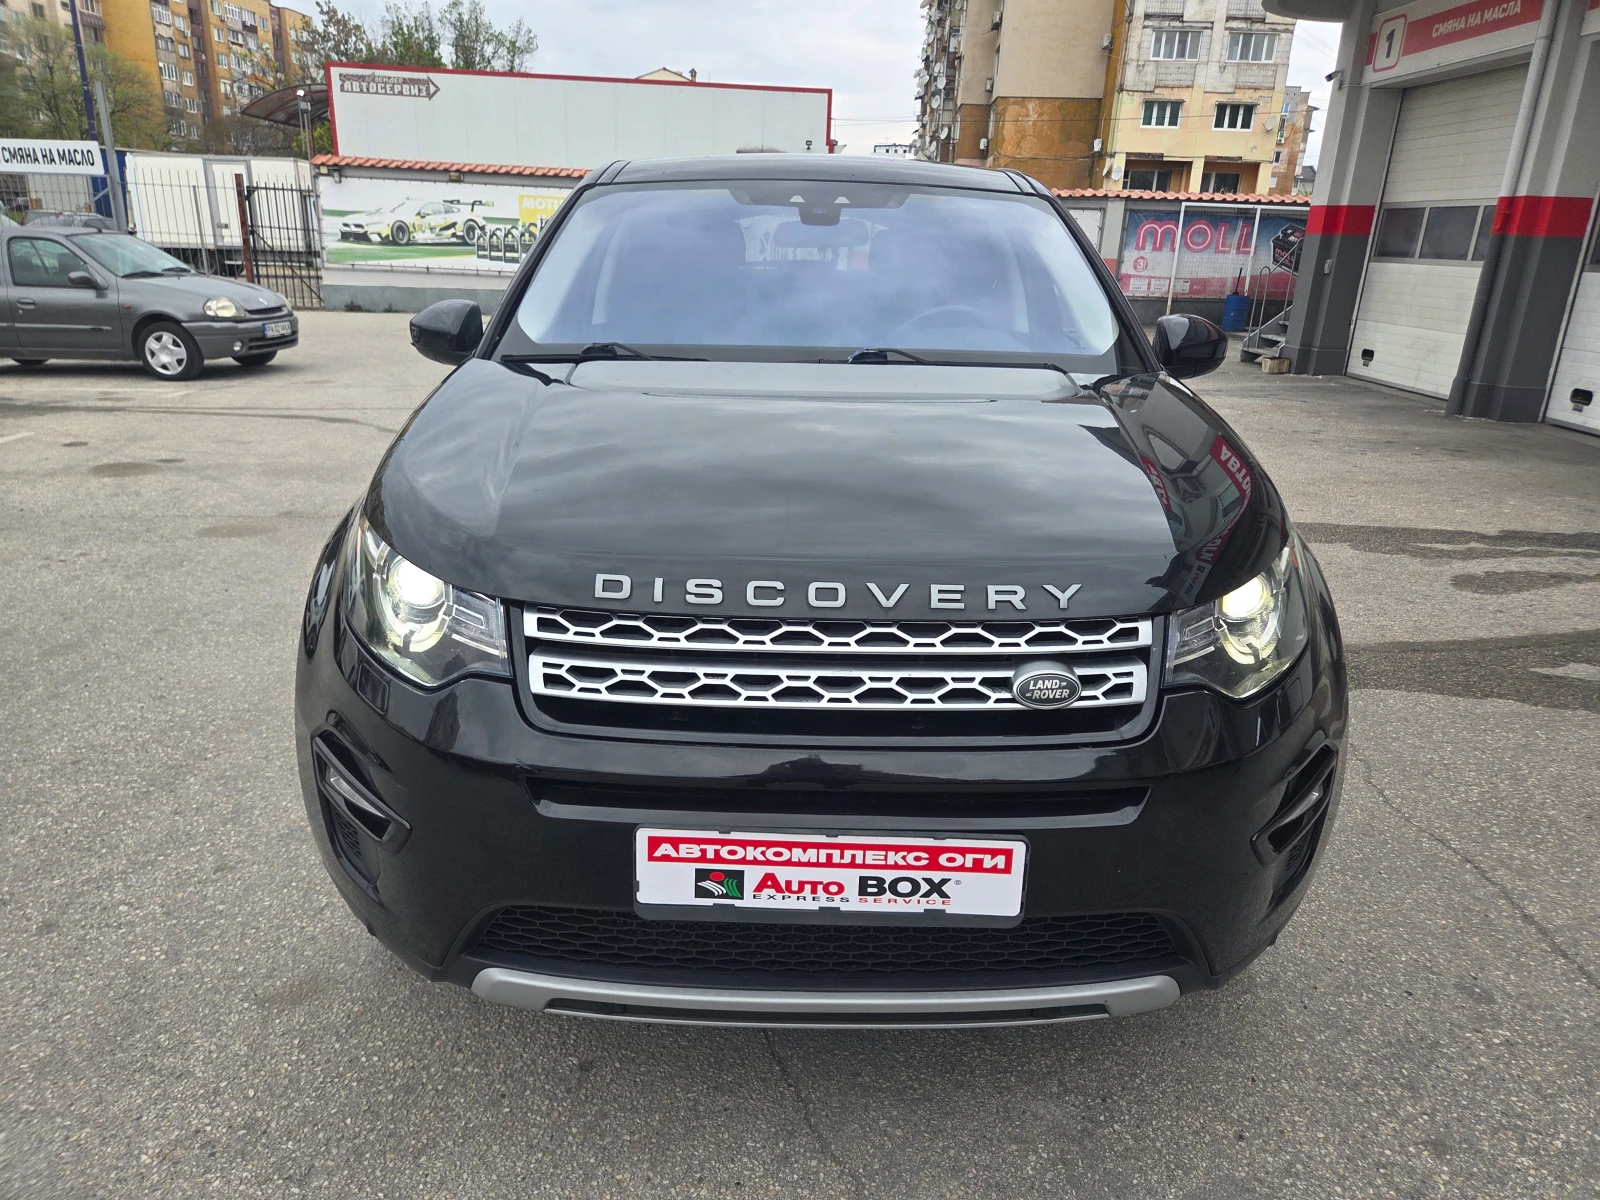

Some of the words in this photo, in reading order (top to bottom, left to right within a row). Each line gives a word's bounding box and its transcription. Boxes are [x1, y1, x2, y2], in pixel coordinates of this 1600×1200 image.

[1432, 15, 1466, 38] СМЯНА
[1466, 12, 1481, 28] НА
[1482, 0, 1521, 24] МАСЛА
[1385, 28, 1396, 59] 1
[343, 81, 427, 97] АВТОСЕРВИЗ
[1, 146, 40, 165] СМЯНА
[40, 148, 57, 166] НА
[57, 148, 95, 167] МАСЛО
[595, 573, 1083, 610] DISCOVERY
[1029, 680, 1060, 690] LAND
[1032, 689, 1070, 699] ROVER
[652, 843, 930, 866] АВТОКОМПЛЕКС
[938, 852, 1006, 870] ОГИ
[858, 875, 952, 899] BOX
[752, 893, 850, 903] EXPRESS
[858, 897, 952, 906] SERVICE
